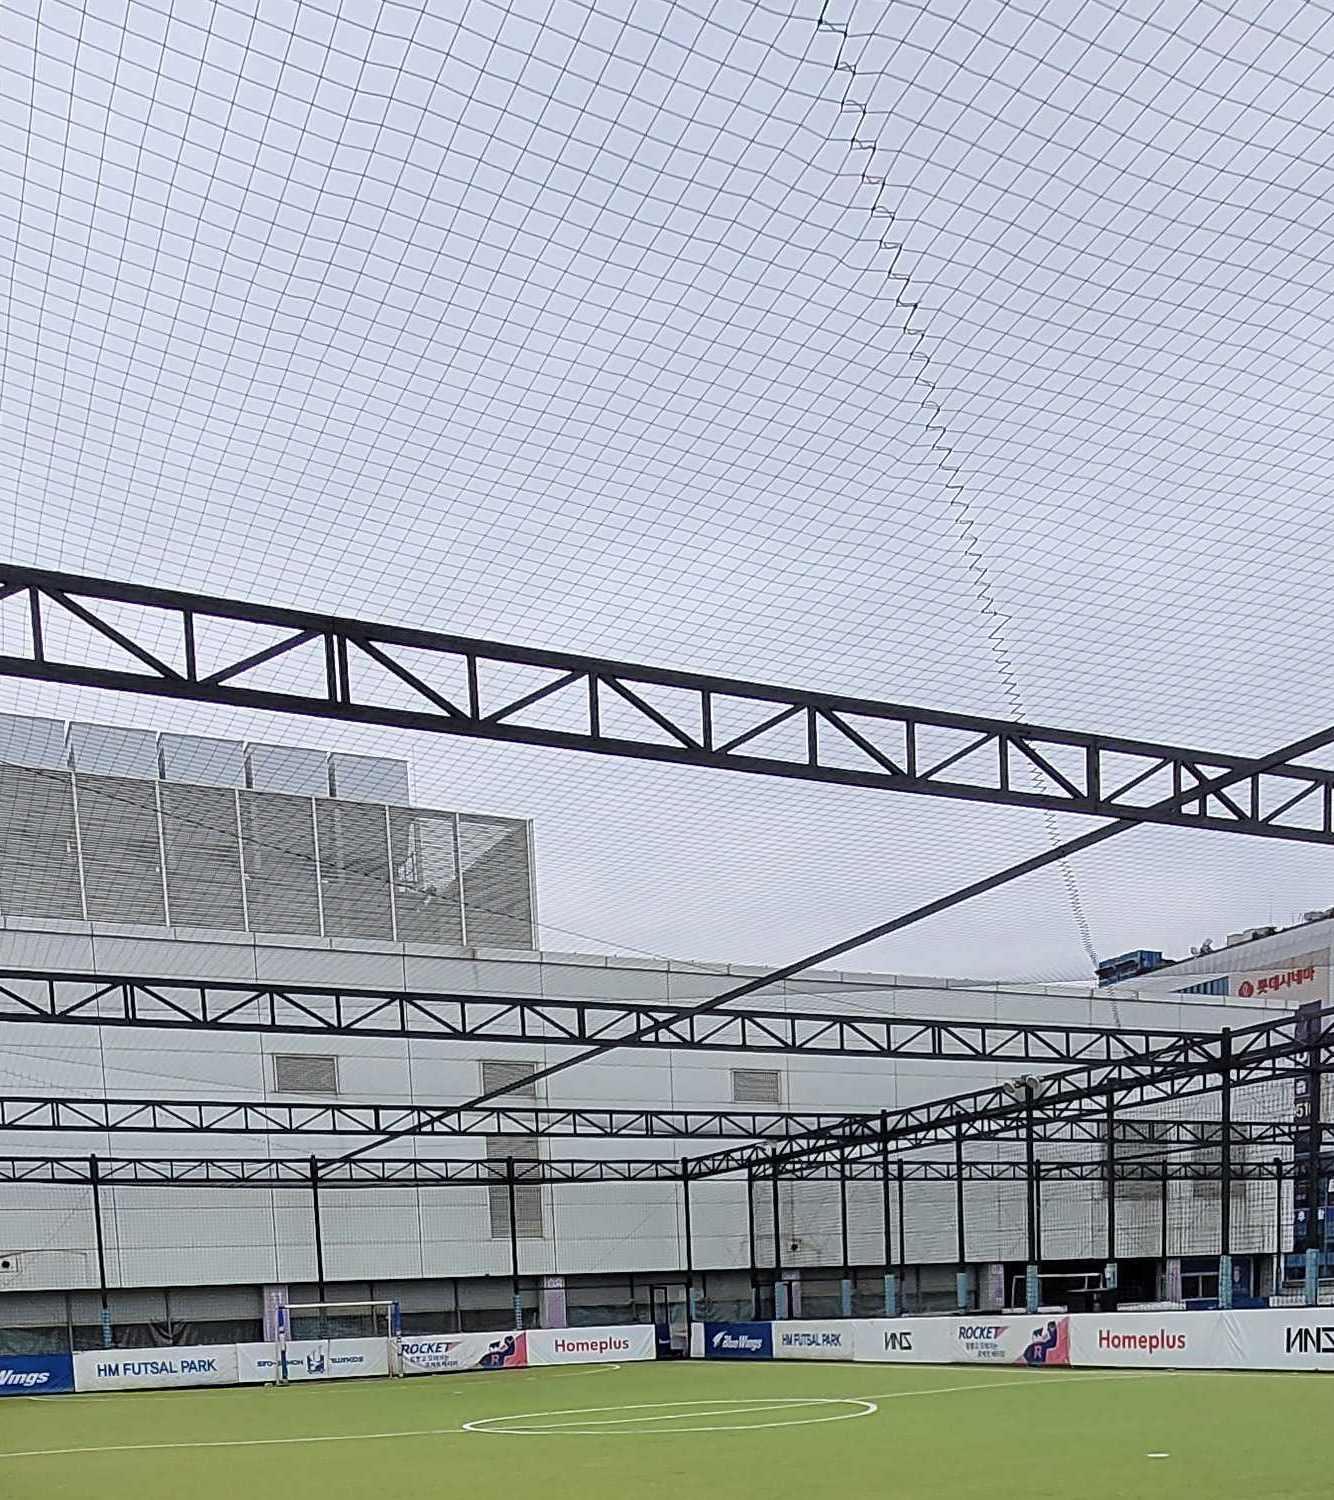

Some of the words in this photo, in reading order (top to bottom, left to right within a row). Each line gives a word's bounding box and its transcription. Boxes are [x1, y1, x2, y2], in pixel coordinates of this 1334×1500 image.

[1257, 965, 1315, 995] 롯데시네마
[822, 1333, 842, 1347] PARK
[958, 1325, 1002, 1340] ROCKET
[1098, 1328, 1186, 1353] Homeplus
[400, 1341, 452, 1355] ROCKET
[554, 1336, 630, 1353] Homeplus
[97, 1361, 119, 1378] HM
[123, 1359, 178, 1377] FUTSAL
[181, 1357, 217, 1375] PARK
